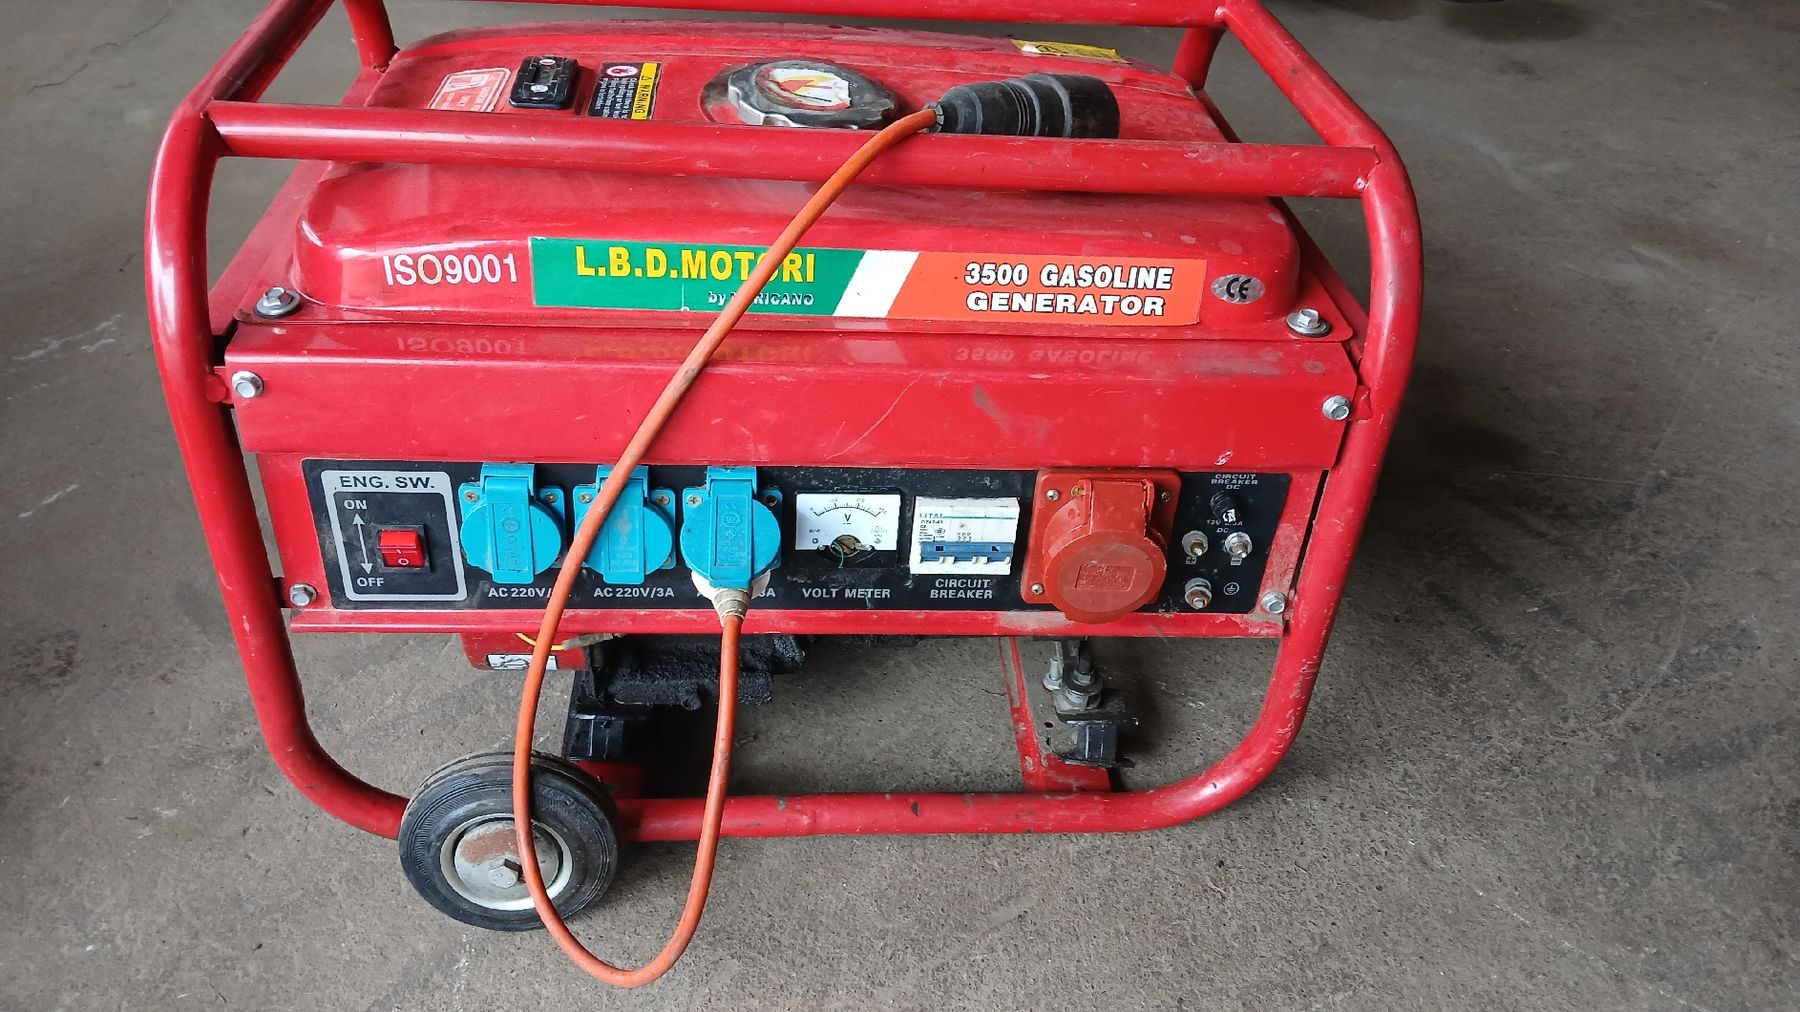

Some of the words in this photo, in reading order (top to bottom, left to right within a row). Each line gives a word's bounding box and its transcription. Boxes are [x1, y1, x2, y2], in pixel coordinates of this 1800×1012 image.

[635, 84, 651, 114] WARNING
[382, 252, 518, 285] ISO9001
[964, 262, 1029, 286] 3500
[1039, 264, 1174, 290] GASOLINE
[1225, 277, 1252, 299] CE
[708, 291, 725, 306] by
[965, 290, 1166, 316] GENERATOR
[339, 475, 390, 489] ENG.
[395, 476, 436, 489] SW.
[344, 499, 368, 510] ON
[844, 513, 852, 522] V
[356, 577, 385, 588] OFF
[935, 578, 991, 588] CIRCUIT
[487, 587, 508, 598] AC
[593, 587, 614, 598] AC
[615, 587, 674, 598] 220V/3A
[802, 588, 842, 599] VOLT
[844, 588, 891, 599] METER
[929, 589, 993, 599] BREAKER
